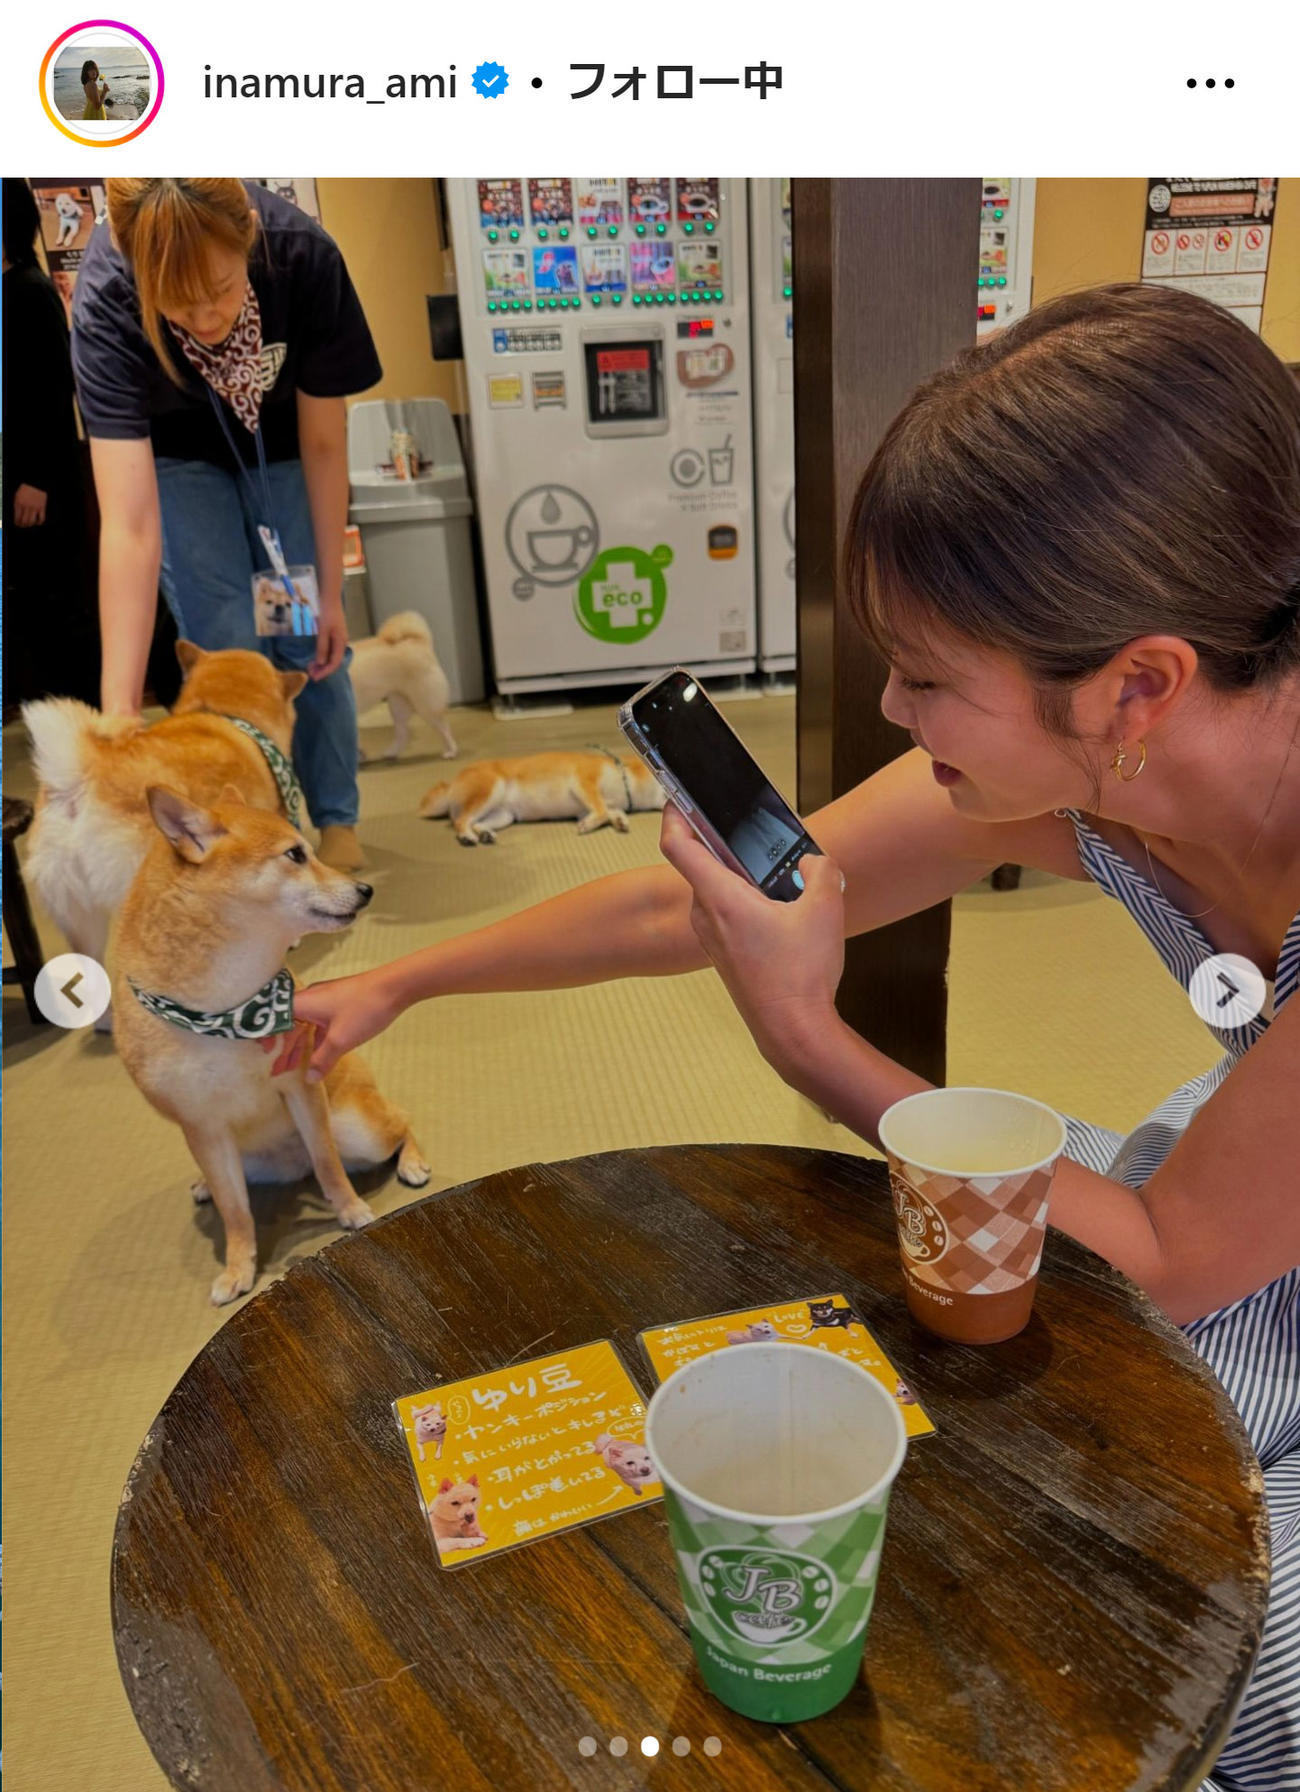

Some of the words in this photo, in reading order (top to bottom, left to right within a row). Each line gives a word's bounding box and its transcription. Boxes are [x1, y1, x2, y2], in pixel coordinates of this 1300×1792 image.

[603, 591, 643, 608] eco
[471, 1362, 584, 1412] ゆり豆
[721, 1565, 803, 1614] JB
[753, 1663, 832, 1682] Beverage
